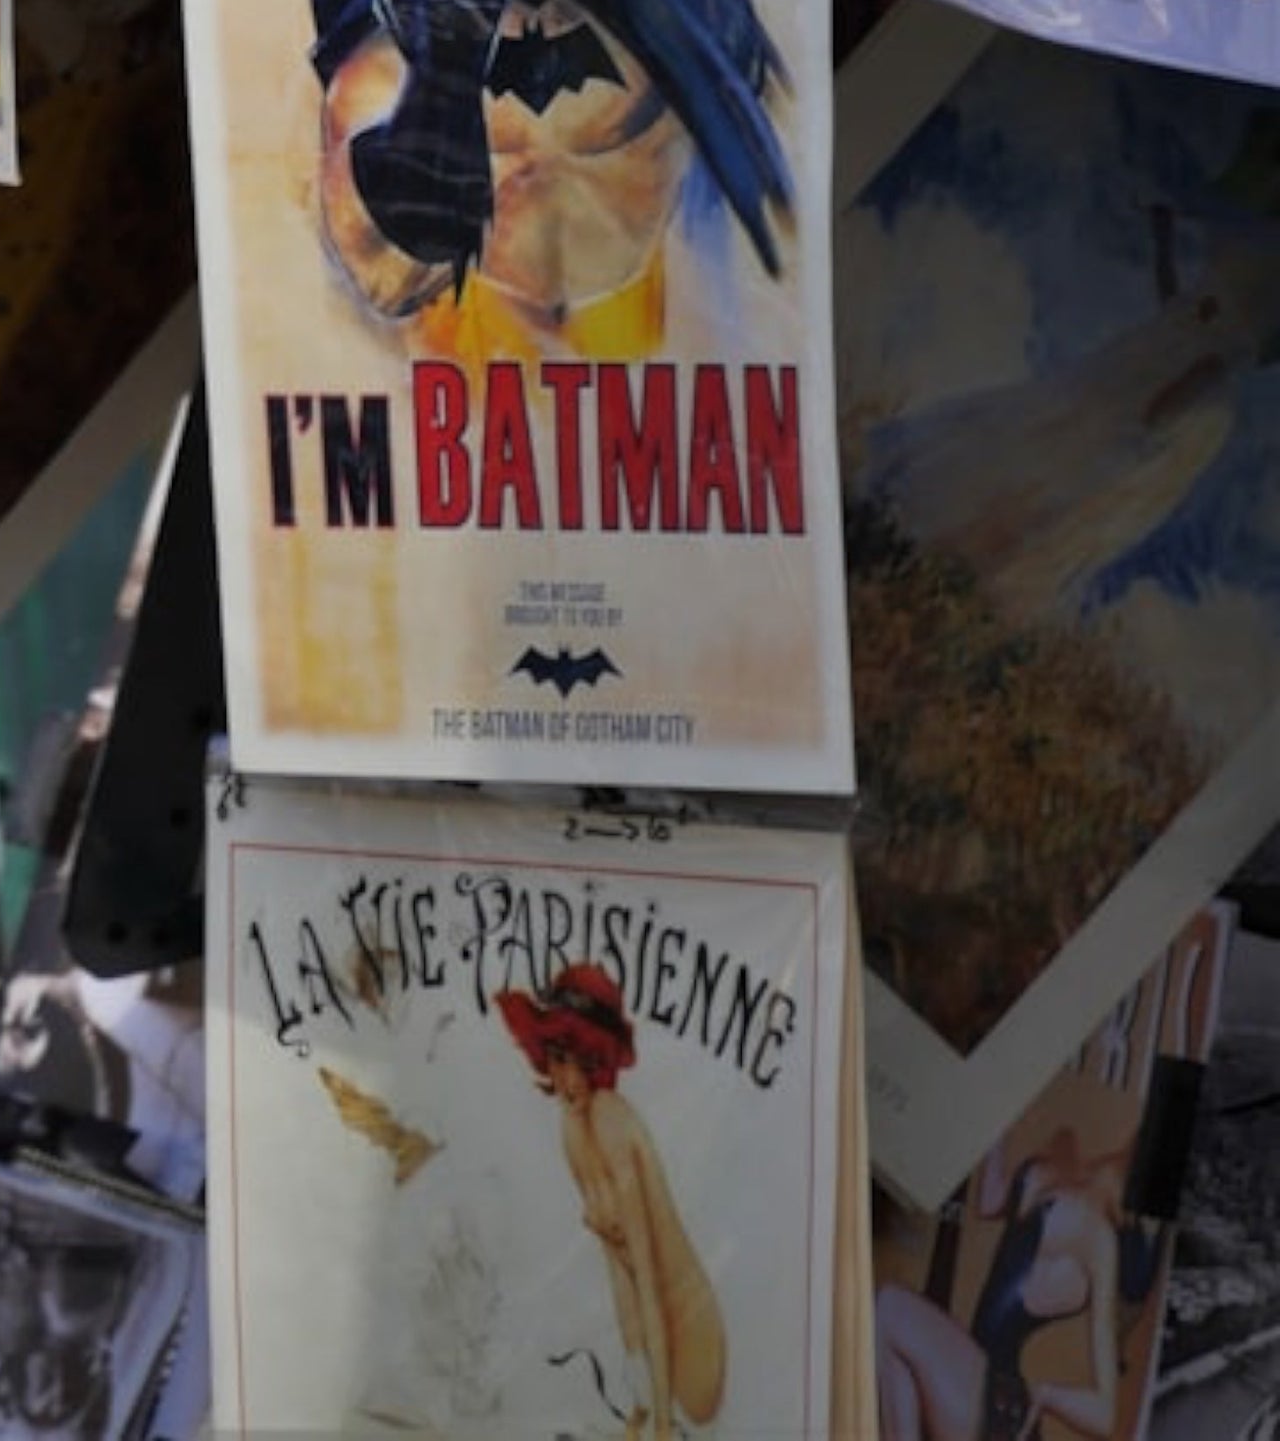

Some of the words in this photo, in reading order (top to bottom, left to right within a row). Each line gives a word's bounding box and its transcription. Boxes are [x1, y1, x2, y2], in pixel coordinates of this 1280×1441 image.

[263, 393, 397, 529] I'M
[412, 360, 806, 536] BATMAN
[432, 708, 466, 739] THE
[470, 709, 545, 742] BATMAN
[549, 711, 570, 742] OF
[574, 712, 651, 743] GOTHAM
[655, 713, 695, 745] CITY
[247, 915, 355, 1060] LA
